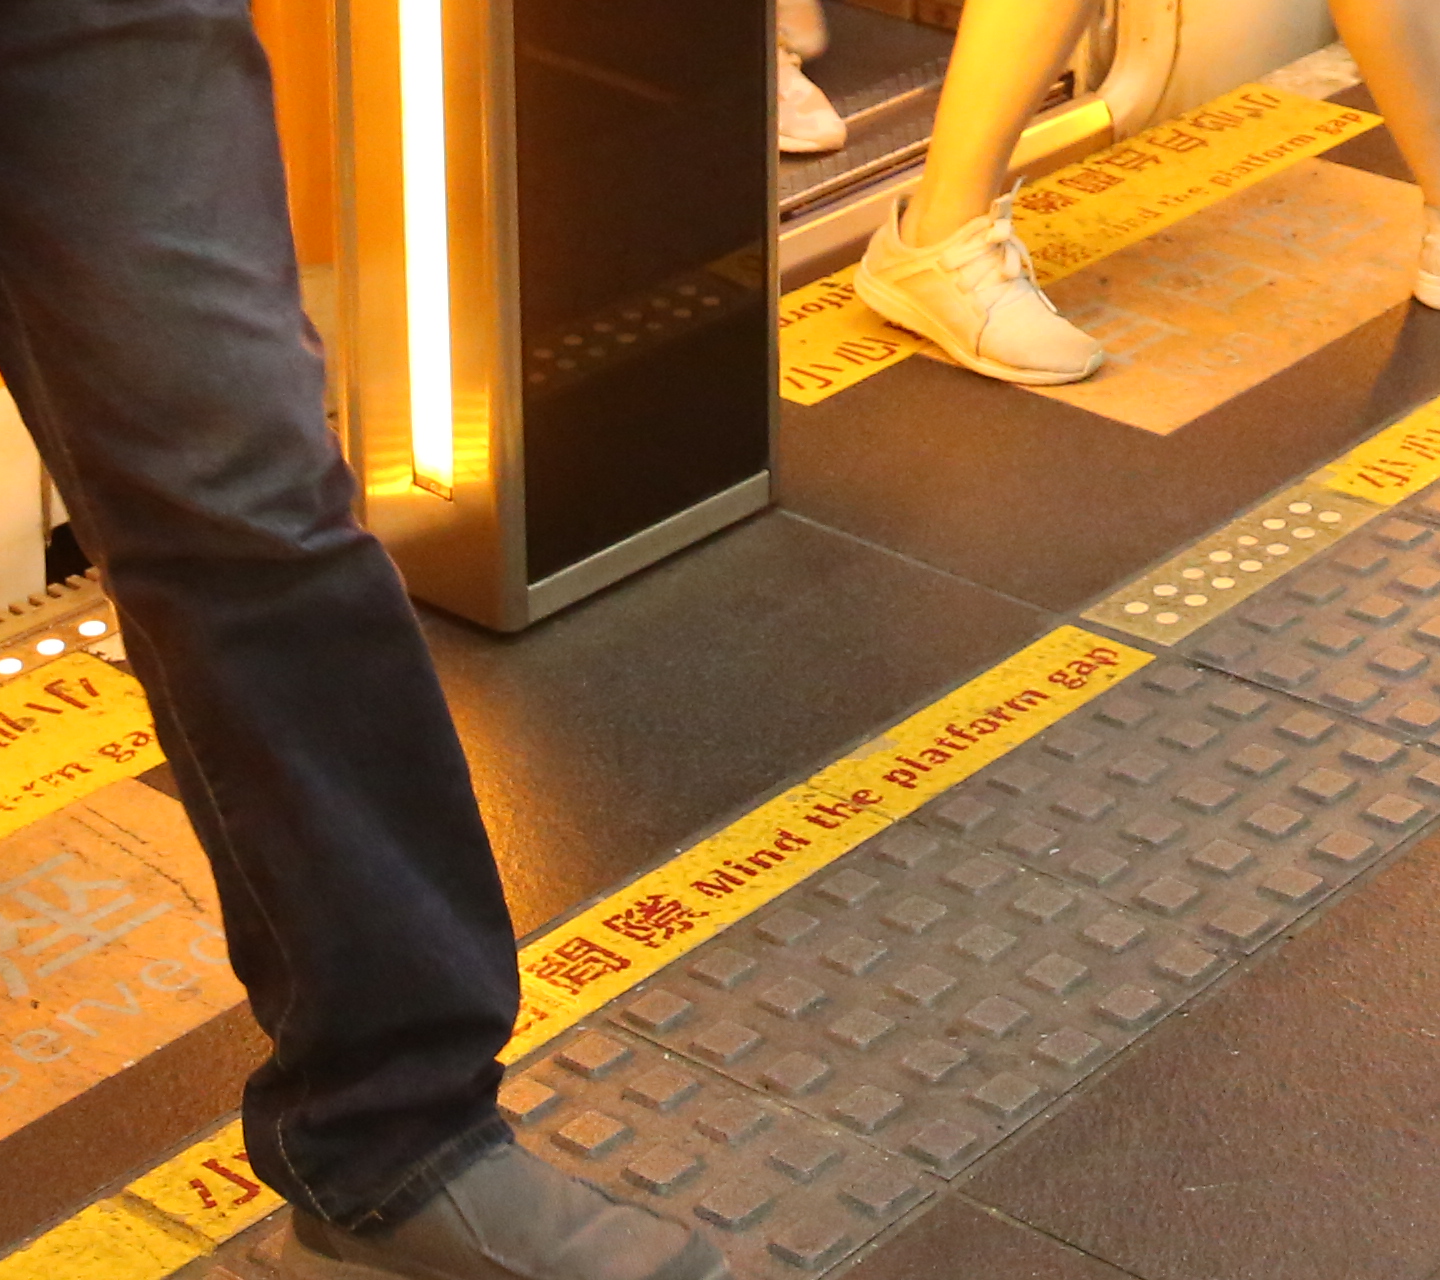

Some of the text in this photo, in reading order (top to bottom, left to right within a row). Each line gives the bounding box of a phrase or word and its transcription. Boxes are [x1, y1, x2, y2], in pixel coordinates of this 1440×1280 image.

[691, 827, 811, 901] Mind
[805, 787, 885, 832] the
[882, 686, 1050, 790] platform
[1048, 644, 1121, 692] gap
